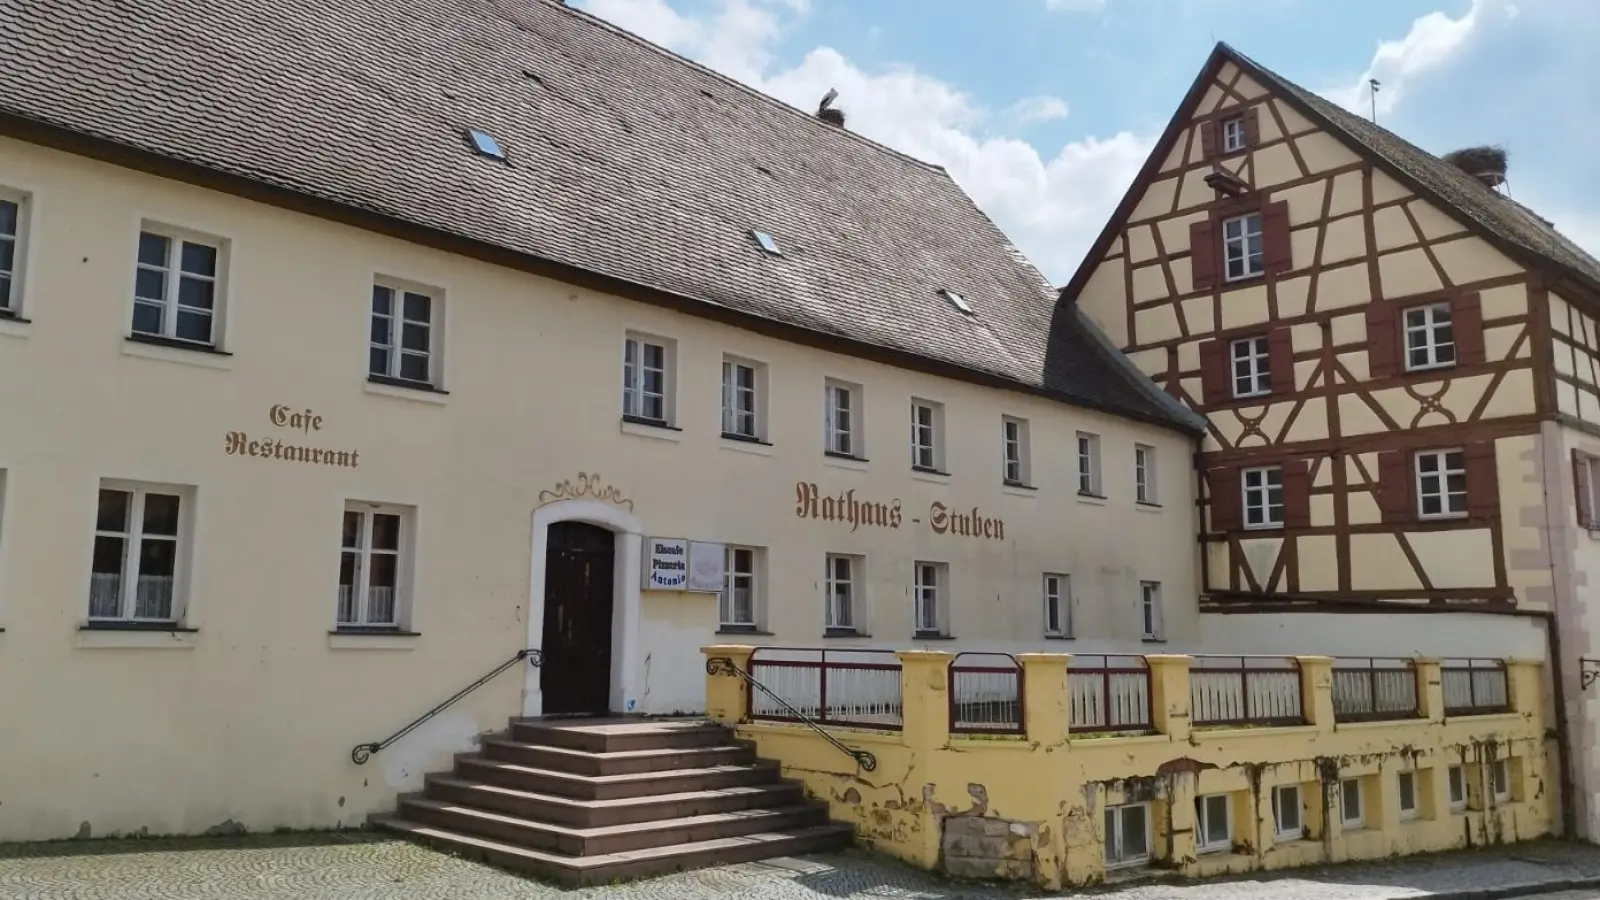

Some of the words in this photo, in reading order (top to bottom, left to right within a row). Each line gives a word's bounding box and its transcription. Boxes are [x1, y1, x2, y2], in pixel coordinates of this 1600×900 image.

[269, 404, 323, 436] Cafe
[225, 430, 359, 468] Restaurant
[796, 481, 902, 532] Rathaus
[930, 501, 1005, 540] Stuben
[651, 571, 686, 586] Antonio
[652, 558, 686, 570] Pizzeria
